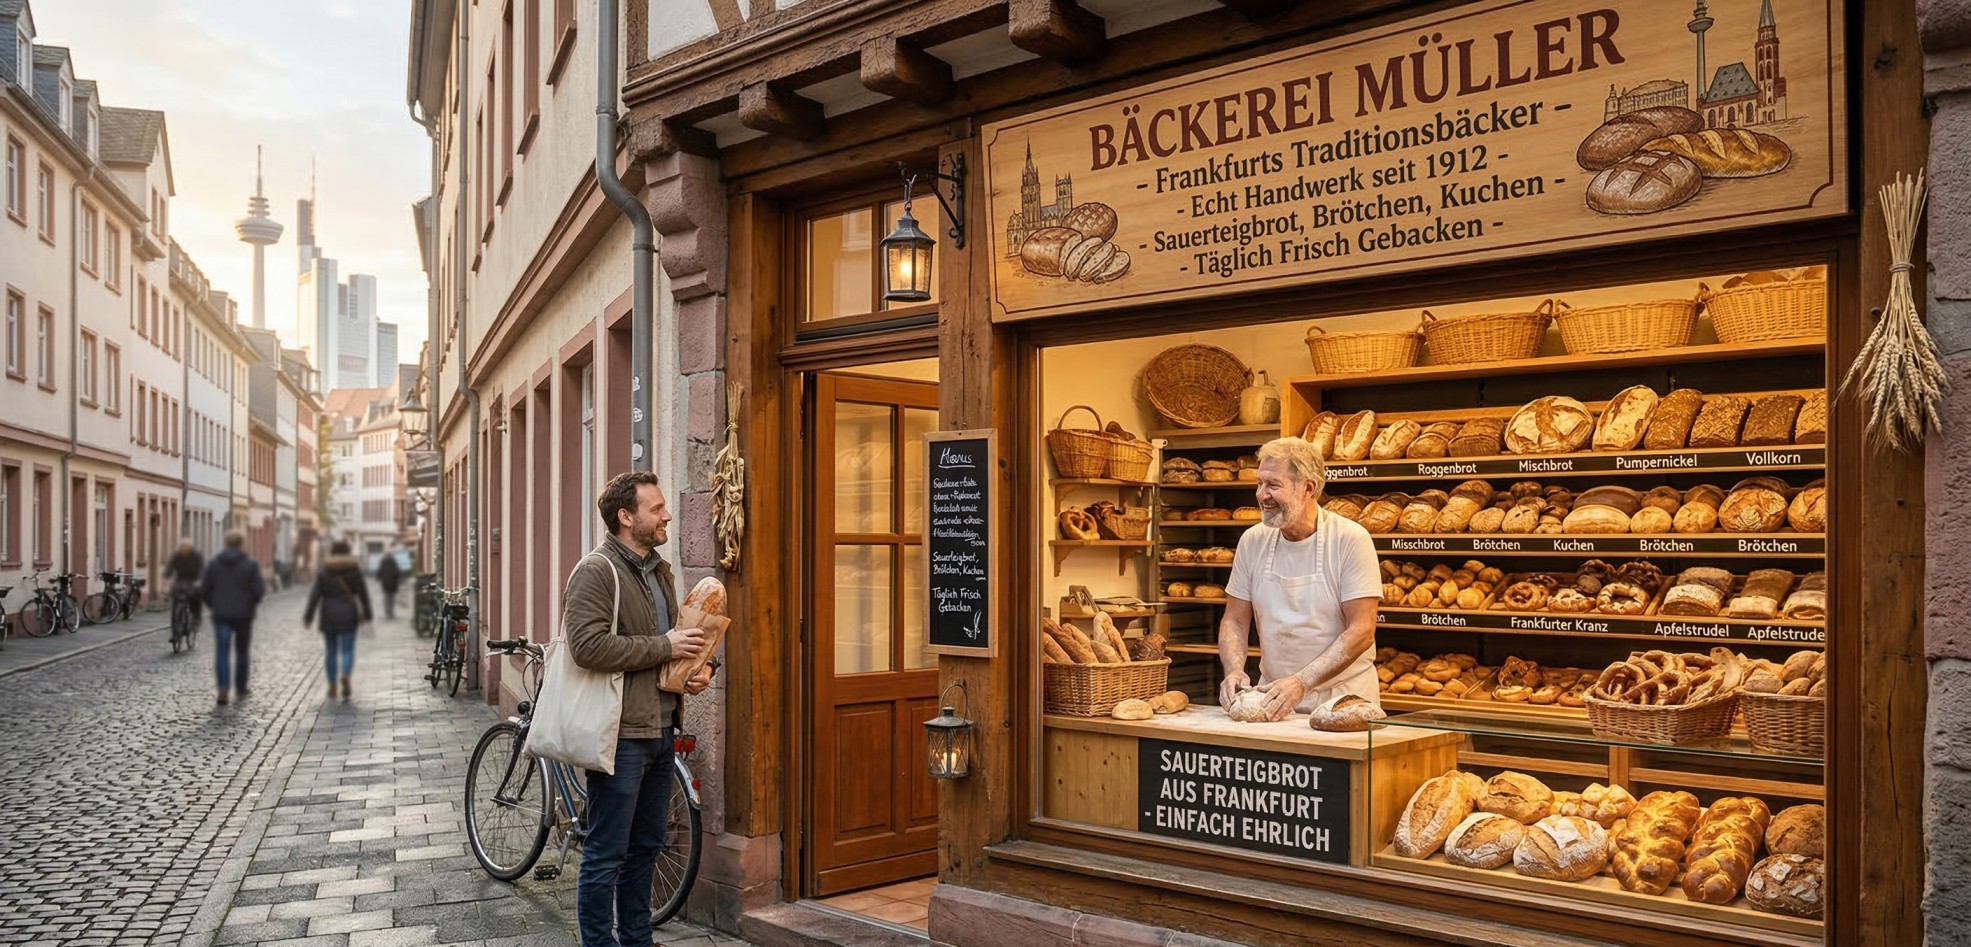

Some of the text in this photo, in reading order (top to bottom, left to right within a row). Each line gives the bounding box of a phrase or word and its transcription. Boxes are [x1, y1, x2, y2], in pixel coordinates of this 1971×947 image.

[1089, 8, 1626, 172] BÄCKEREI MÜLLER
[1155, 150, 1284, 194] Frankfurts
[1290, 101, 1544, 170] Traditionsbäcker
[1191, 189, 1238, 218] Echt
[1244, 166, 1365, 210] Handwerk
[1372, 158, 1416, 189] seit
[1426, 145, 1488, 179] 1912
[1154, 211, 1305, 252] Sauerteigbrot,
[1312, 194, 1432, 229] Brötchen,
[1440, 173, 1545, 209] Kuchen
[1194, 245, 1273, 278] Täglich
[1279, 232, 1350, 264] Frisch
[1358, 216, 1483, 252] Gebacken
[1519, 458, 1574, 472] Mischbrot
[1616, 454, 1698, 471] Pumpernickel
[1746, 452, 1801, 465] Vollkorn
[1325, 466, 1368, 480] ggenbrot
[1418, 463, 1477, 478] Roggenbrot
[1392, 539, 1445, 550] Misschbrot
[1553, 540, 1594, 551] Kuchen
[1640, 539, 1694, 551] Brötchen
[1738, 539, 1797, 552] Brötchen
[1421, 614, 1466, 626] Brötchen
[1511, 616, 1608, 632] Frankfurter Kranz
[1654, 622, 1729, 638] Apfelstrudel
[1160, 749, 1322, 790] SAUERTEIGBROT
[1160, 778, 1323, 820] AUS FRANKFURT
[1156, 805, 1235, 838] EINFACH
[1242, 817, 1330, 852] EHRLICH
